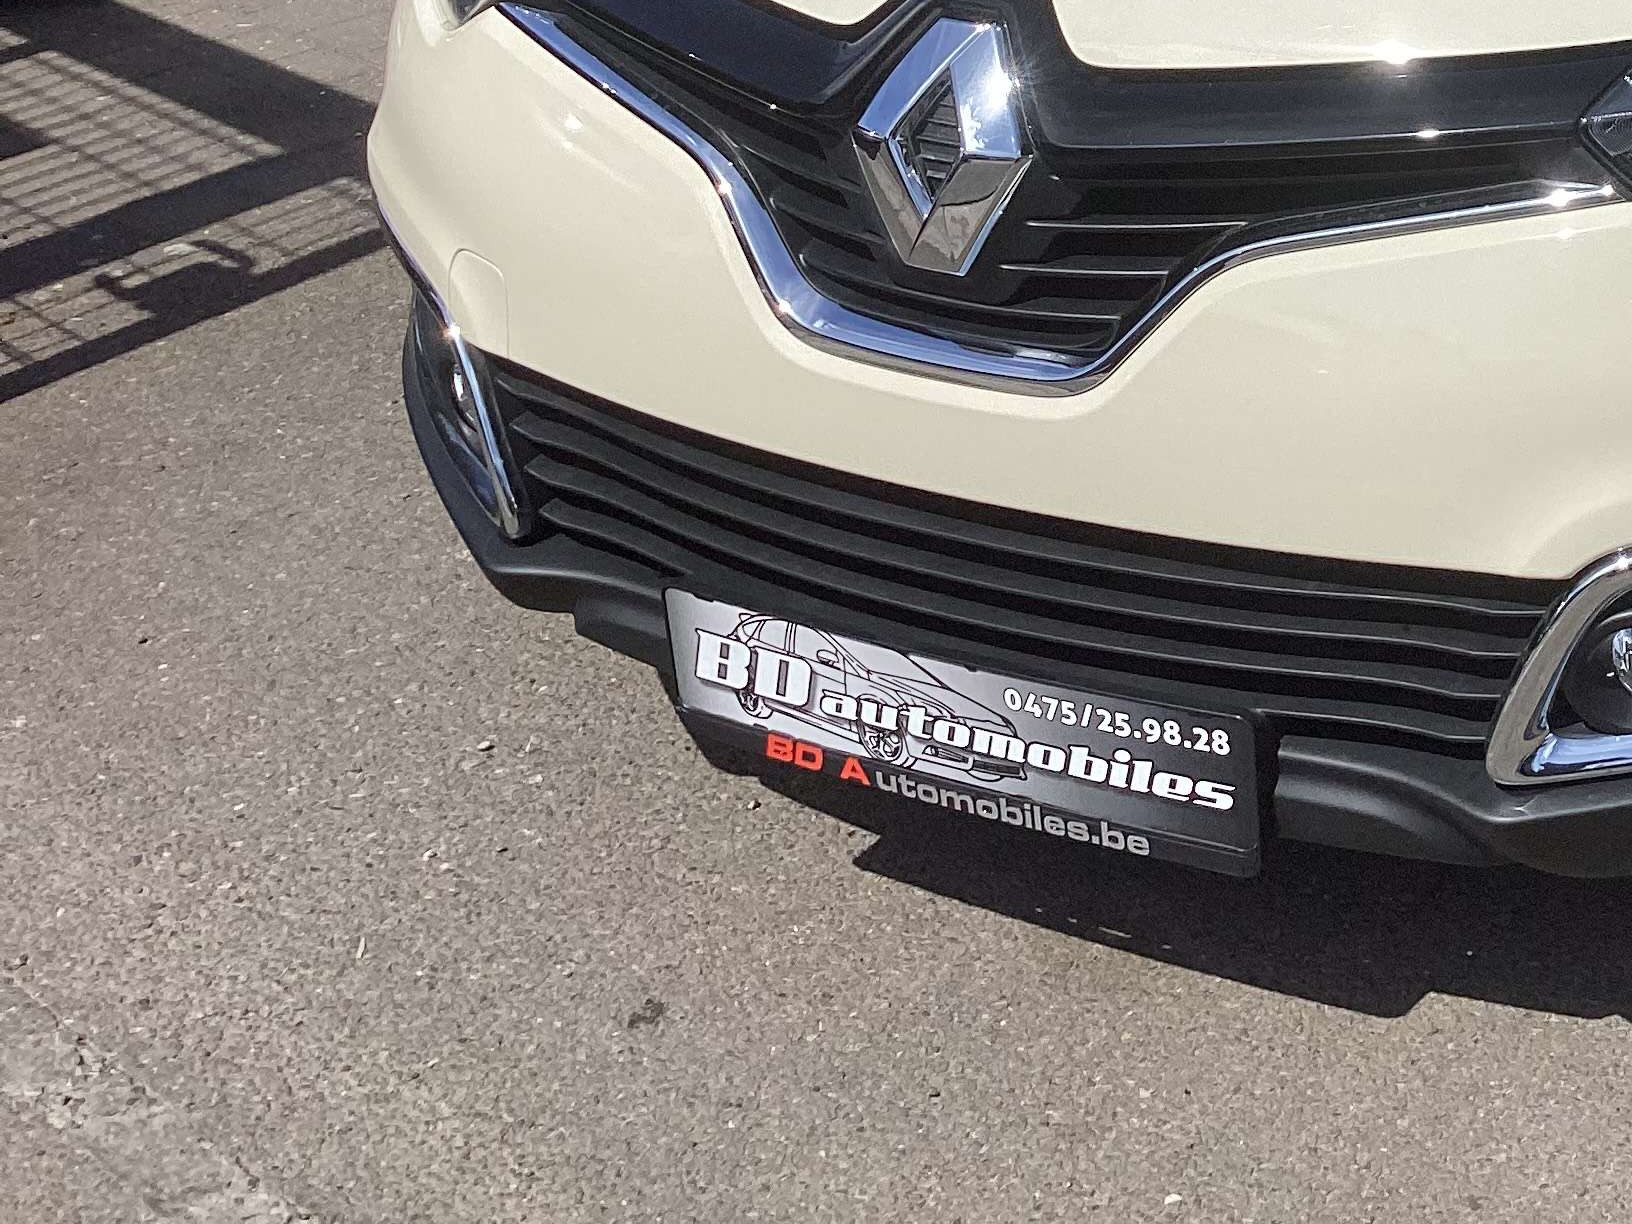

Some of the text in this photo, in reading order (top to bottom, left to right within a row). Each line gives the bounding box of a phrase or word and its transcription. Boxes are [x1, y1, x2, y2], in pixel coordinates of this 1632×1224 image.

[696, 629, 1237, 810] BD automobiles
[765, 732, 824, 772] BD
[1003, 687, 1231, 756] 0475/25.98.28
